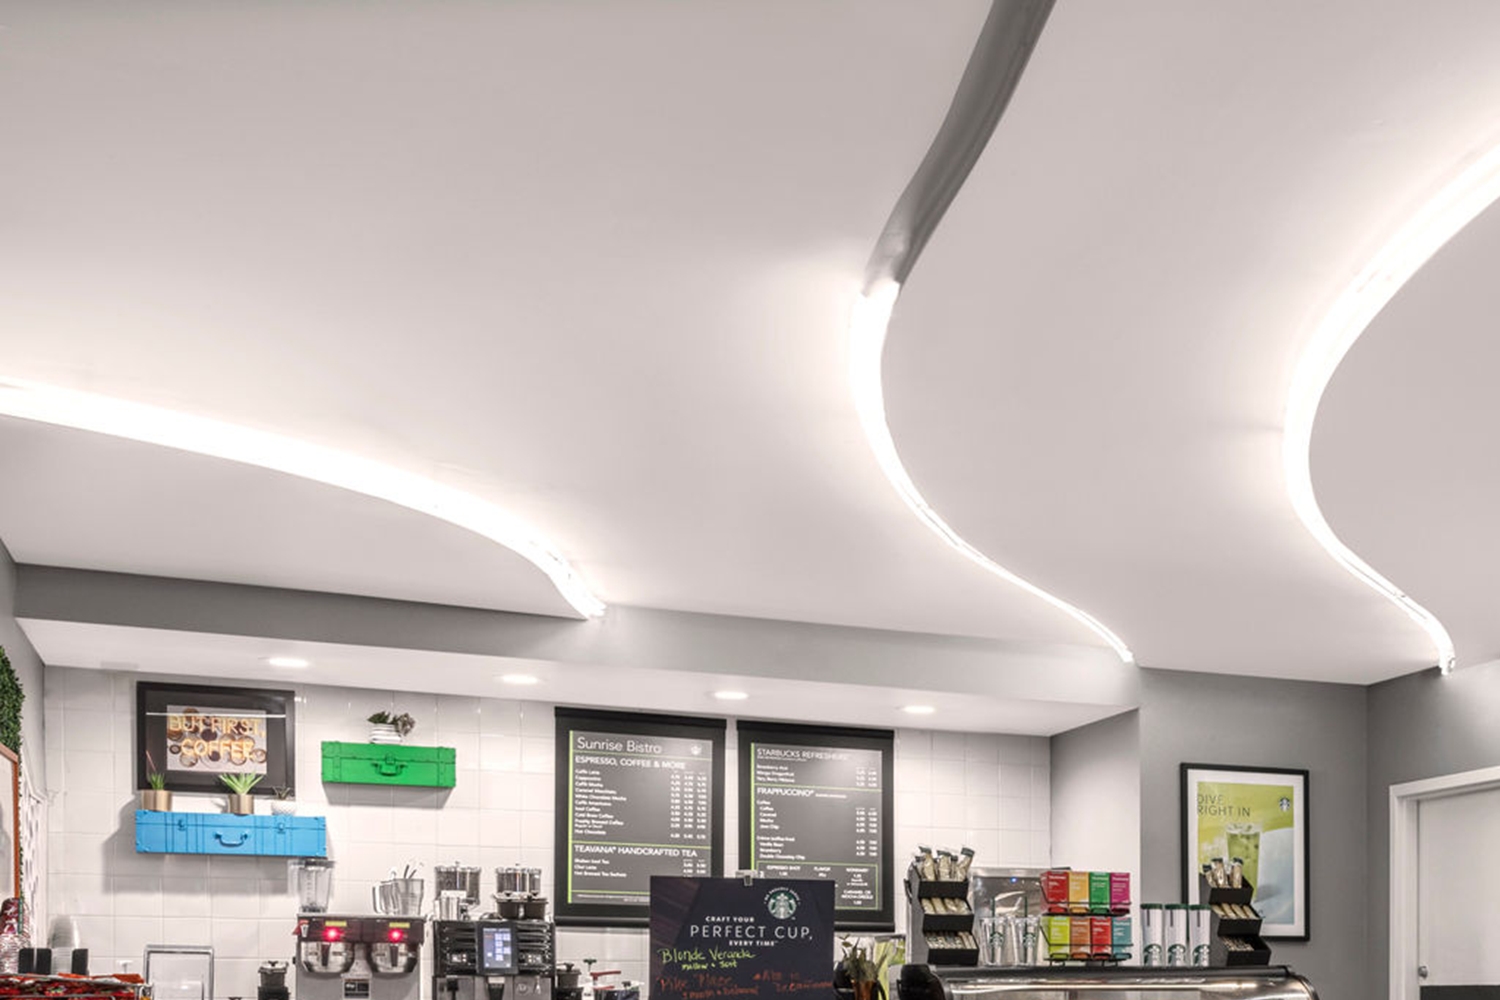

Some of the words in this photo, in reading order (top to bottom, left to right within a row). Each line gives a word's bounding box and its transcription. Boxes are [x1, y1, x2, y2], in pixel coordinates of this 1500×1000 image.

[181, 738, 256, 760] COFFEE
[577, 736, 622, 751] Sunrise
[626, 740, 662, 754] Bistro
[757, 748, 800, 758] STARBUCKS
[575, 755, 618, 767] ESPRESSO,
[620, 757, 653, 767] COFFEE
[654, 760, 660, 768] &
[662, 760, 686, 770] MORE
[1197, 793, 1224, 806] DIVE
[1197, 805, 1234, 816] RIGHT
[1238, 807, 1251, 817] IN
[618, 847, 680, 857] HANDCRAFTED
[682, 849, 698, 857] TEA
[690, 925, 766, 939] PERFECT
[774, 926, 813, 940] CUP,
